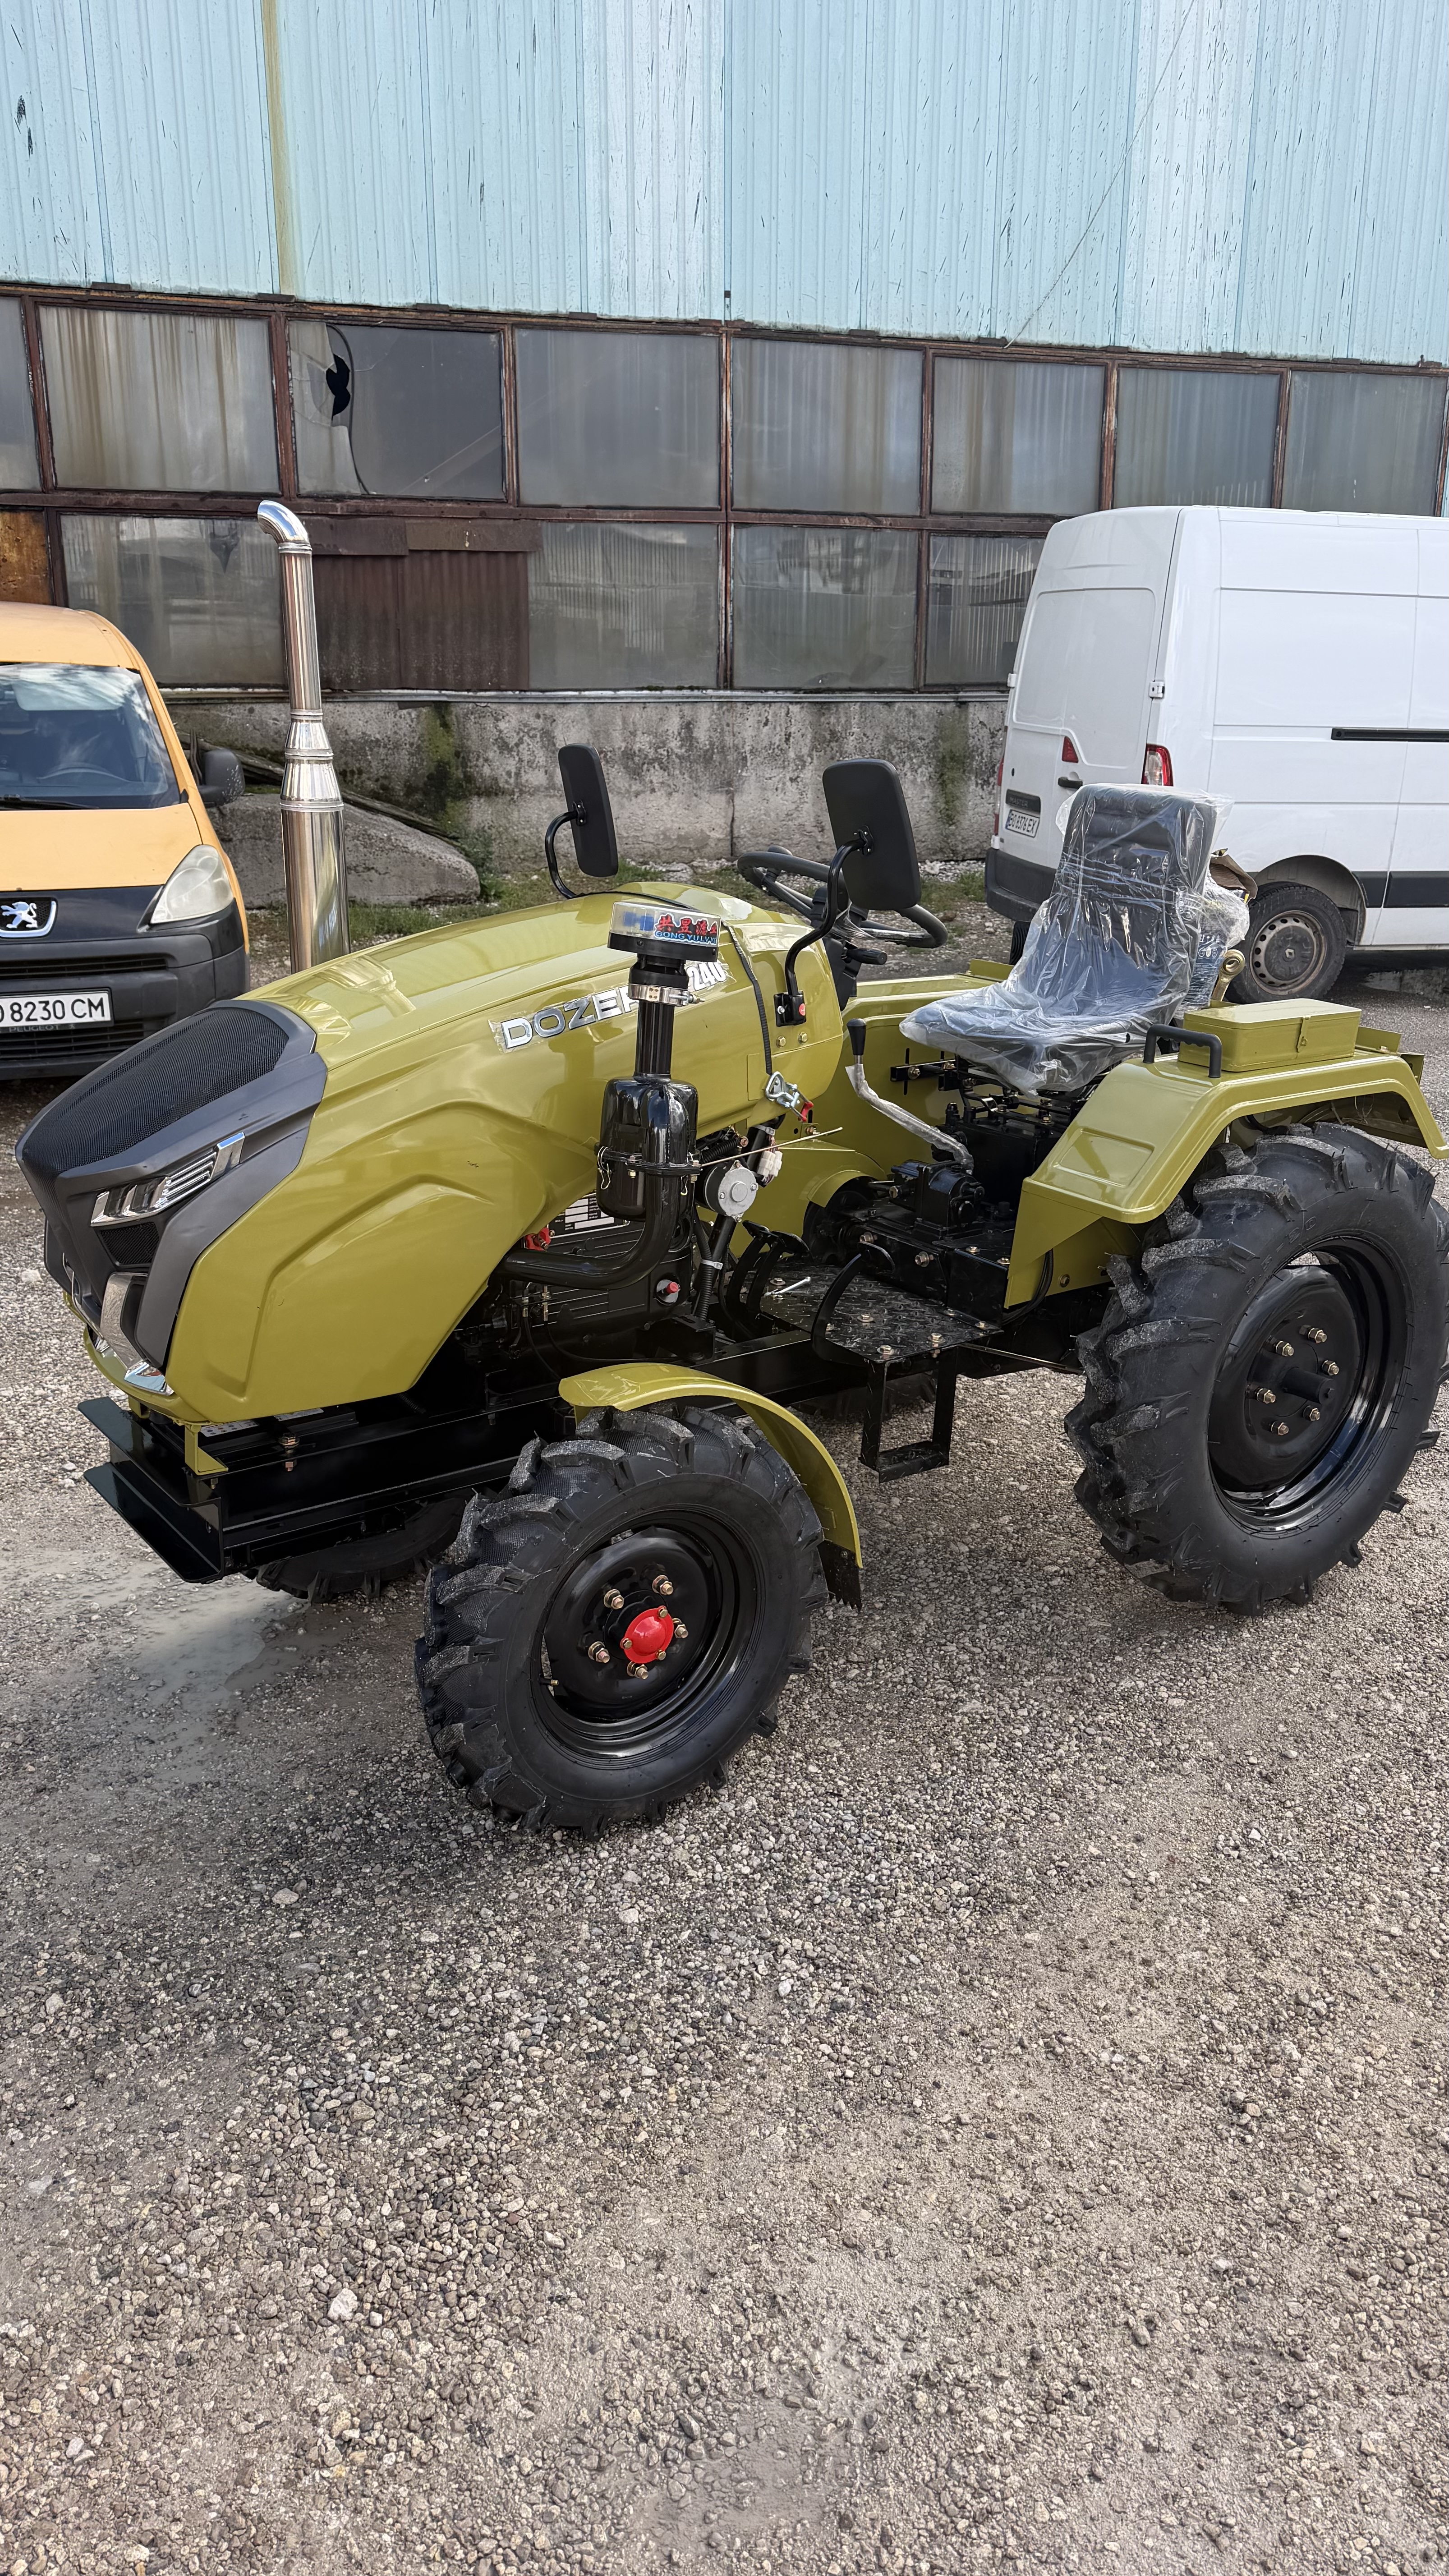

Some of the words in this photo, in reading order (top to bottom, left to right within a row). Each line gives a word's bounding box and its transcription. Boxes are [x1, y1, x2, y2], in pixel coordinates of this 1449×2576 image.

[687, 961, 727, 991] 240
[9, 999, 66, 1022] 8230
[71, 997, 105, 1018] CM
[9, 1024, 60, 1032] PEUGEOT
